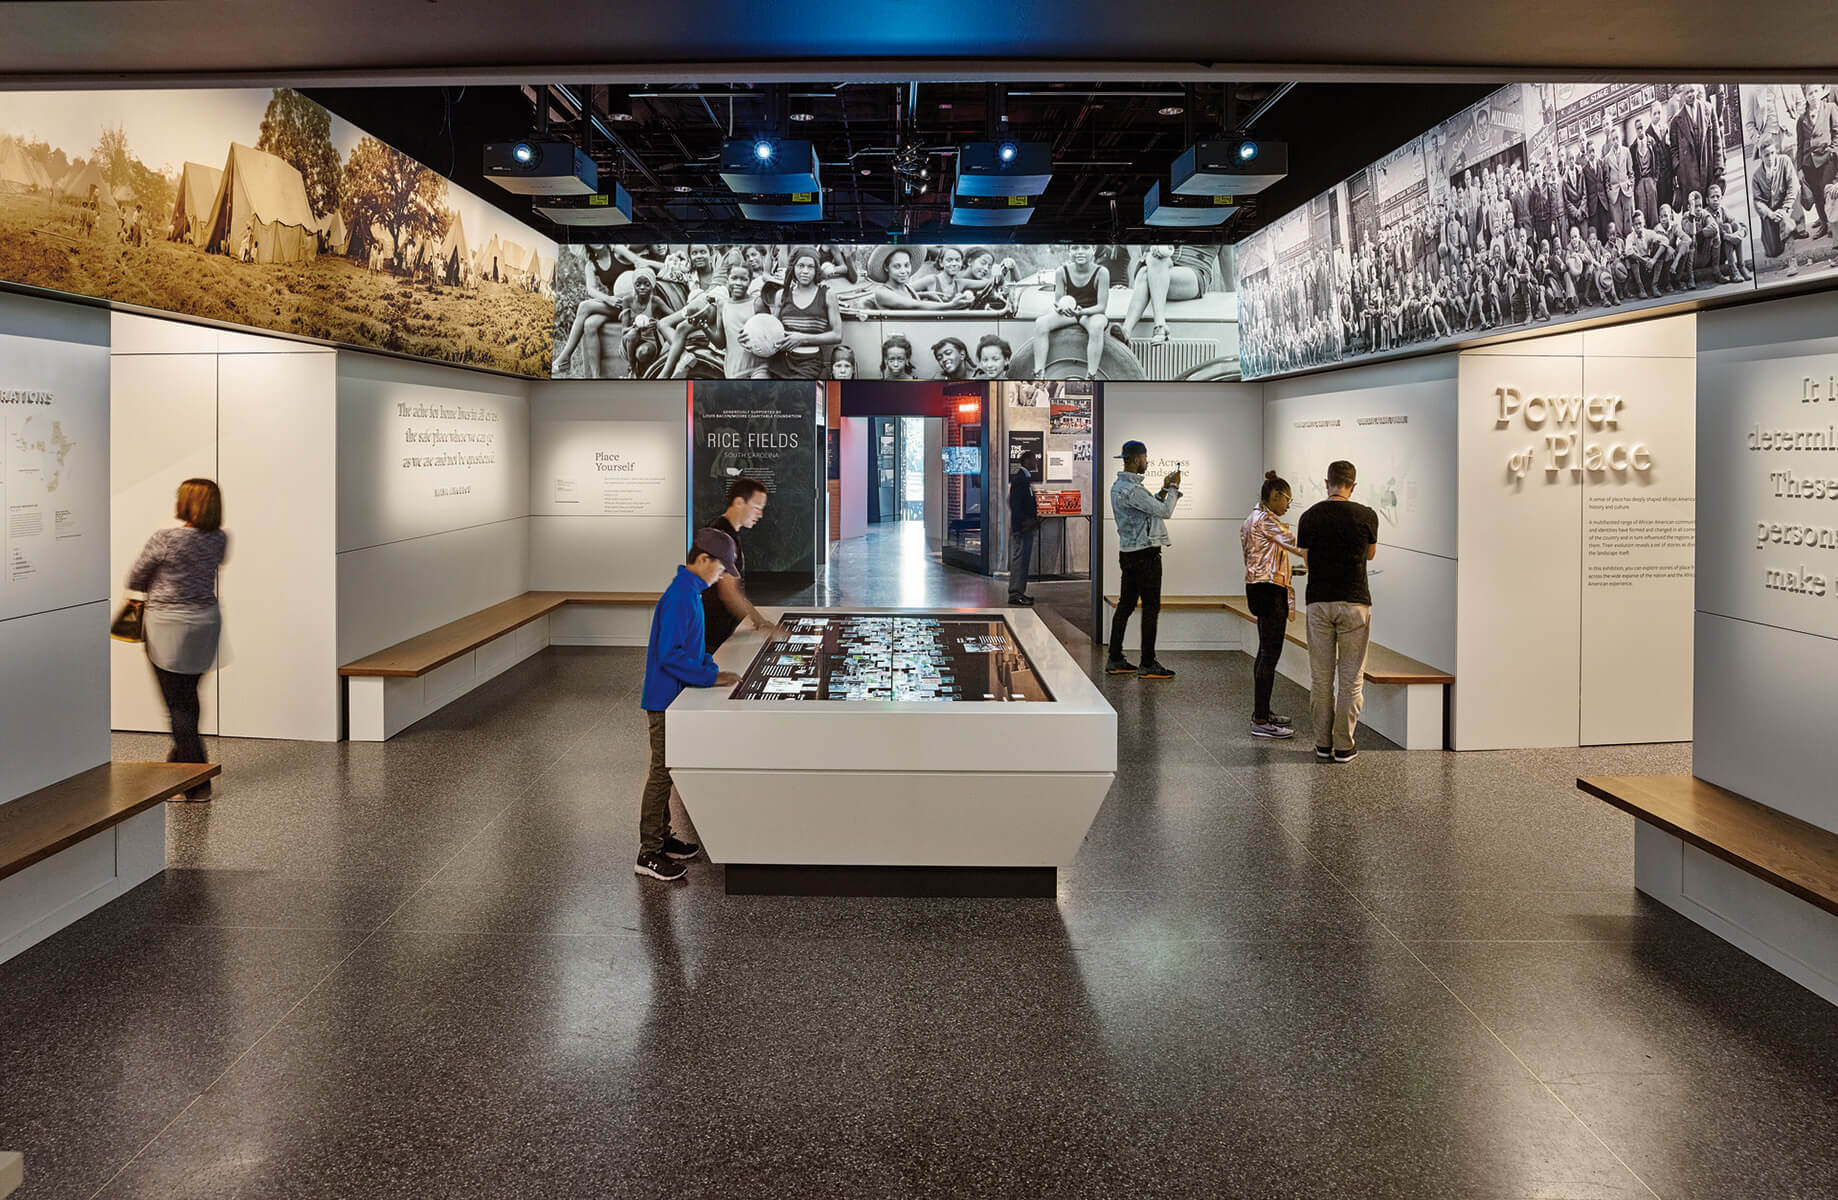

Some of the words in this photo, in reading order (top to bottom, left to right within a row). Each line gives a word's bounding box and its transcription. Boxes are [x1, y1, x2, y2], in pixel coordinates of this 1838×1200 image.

[1801, 377, 1820, 404] It
[1828, 376, 1838, 402] i
[1495, 384, 1624, 431] Power
[707, 433, 740, 448] RICE
[748, 433, 799, 448] FIELDS
[1747, 423, 1838, 452] determi
[595, 452, 620, 462] Place
[595, 462, 636, 472] Yourself
[1508, 447, 1534, 480] of
[1545, 432, 1652, 473] Place
[1769, 470, 1838, 500] These
[1756, 523, 1838, 550] person
[1765, 565, 1826, 598] make
